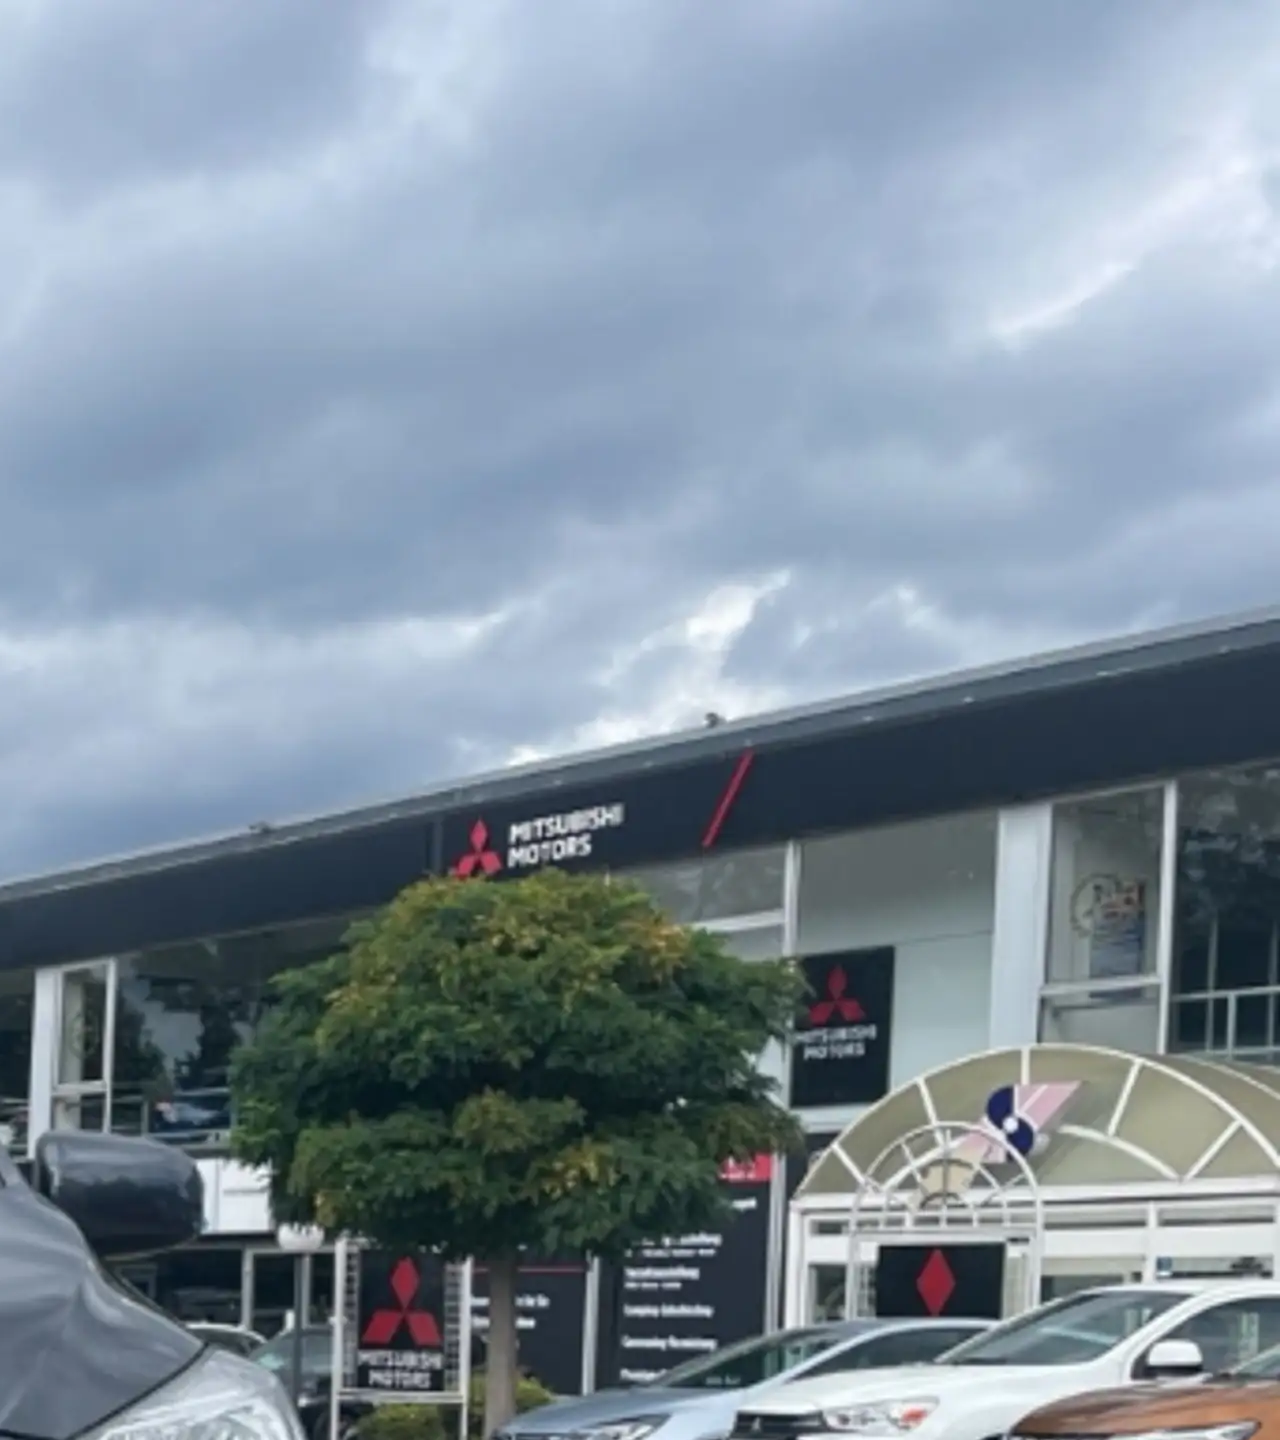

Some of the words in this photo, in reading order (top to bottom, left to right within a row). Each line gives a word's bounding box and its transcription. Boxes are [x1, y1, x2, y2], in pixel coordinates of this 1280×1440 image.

[508, 803, 624, 844] MITSUBISHI
[507, 833, 592, 868] MOTORS
[803, 1041, 865, 1060] MOTORS
[368, 1369, 431, 1389] MOTORS
